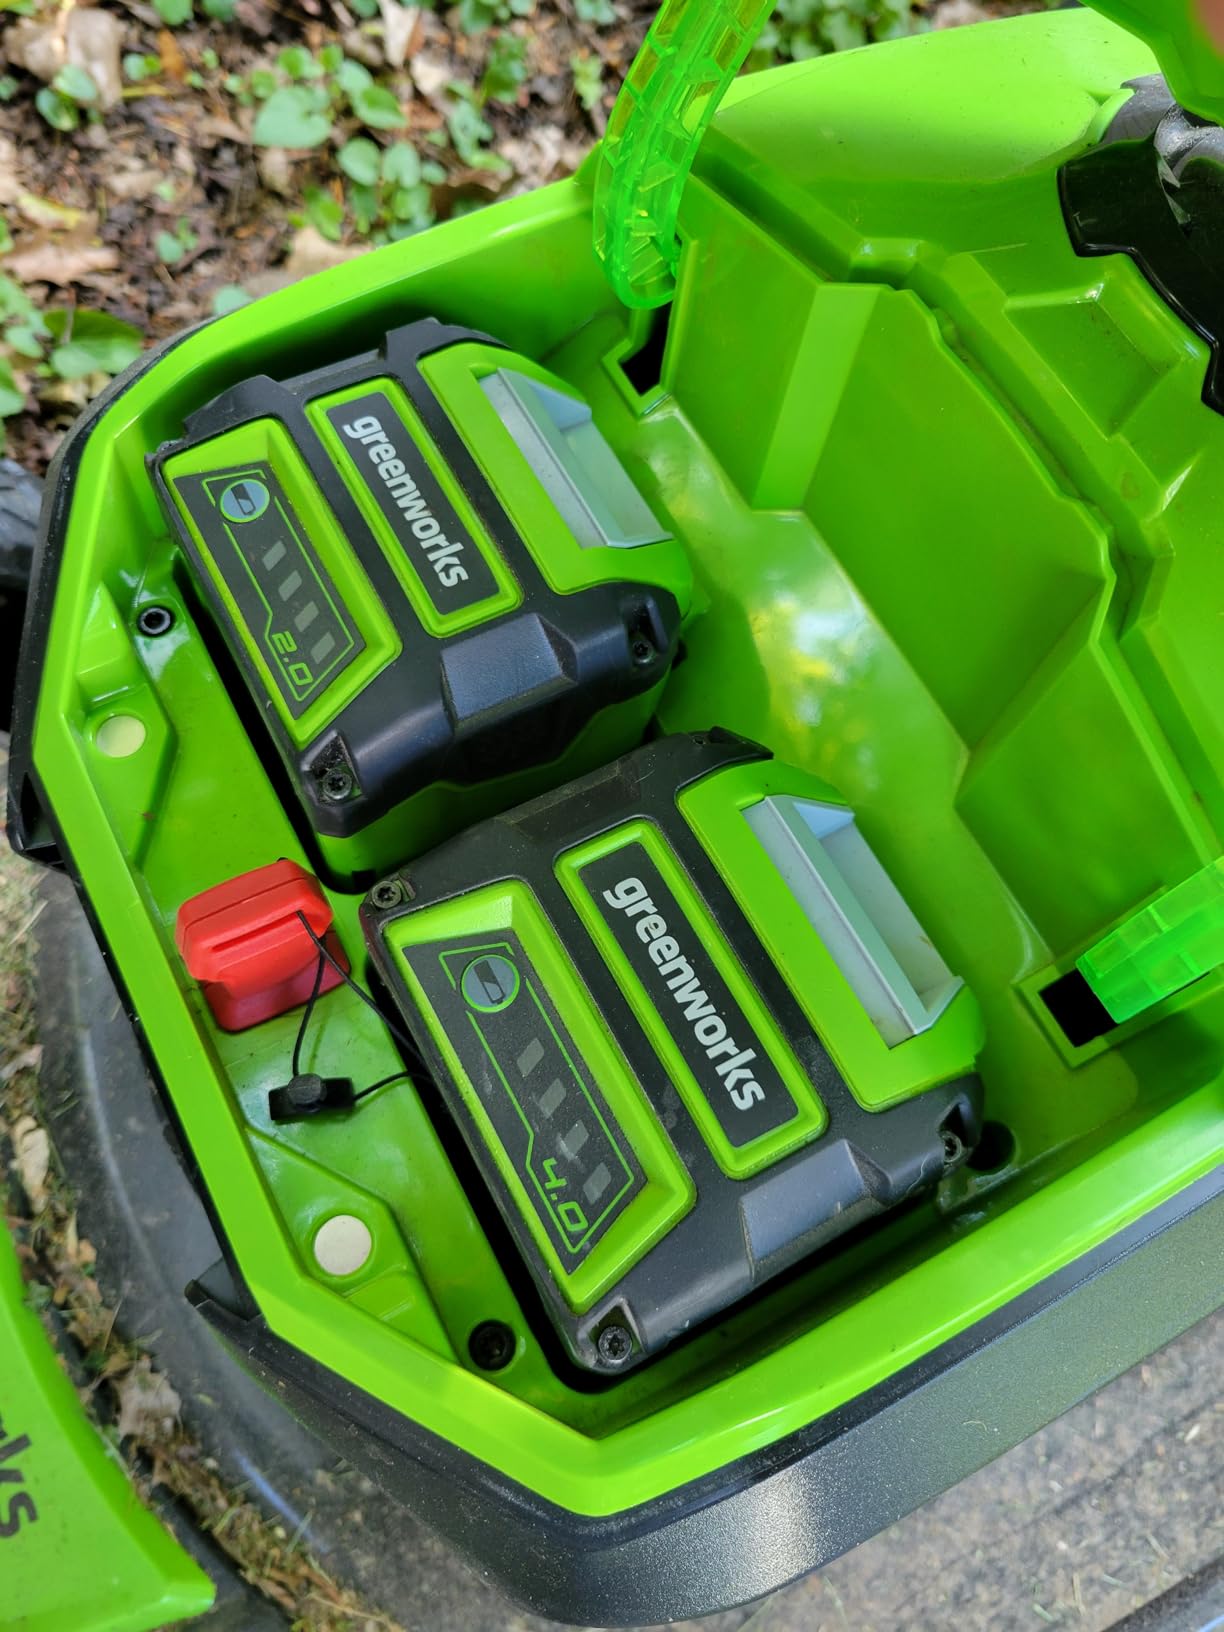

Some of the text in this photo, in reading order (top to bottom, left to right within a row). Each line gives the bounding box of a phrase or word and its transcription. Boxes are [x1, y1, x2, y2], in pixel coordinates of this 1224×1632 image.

[343, 415, 469, 588] greenworks
[271, 630, 314, 687] 2.0
[602, 876, 766, 1112] greenworks
[540, 1157, 588, 1233] 4.0
